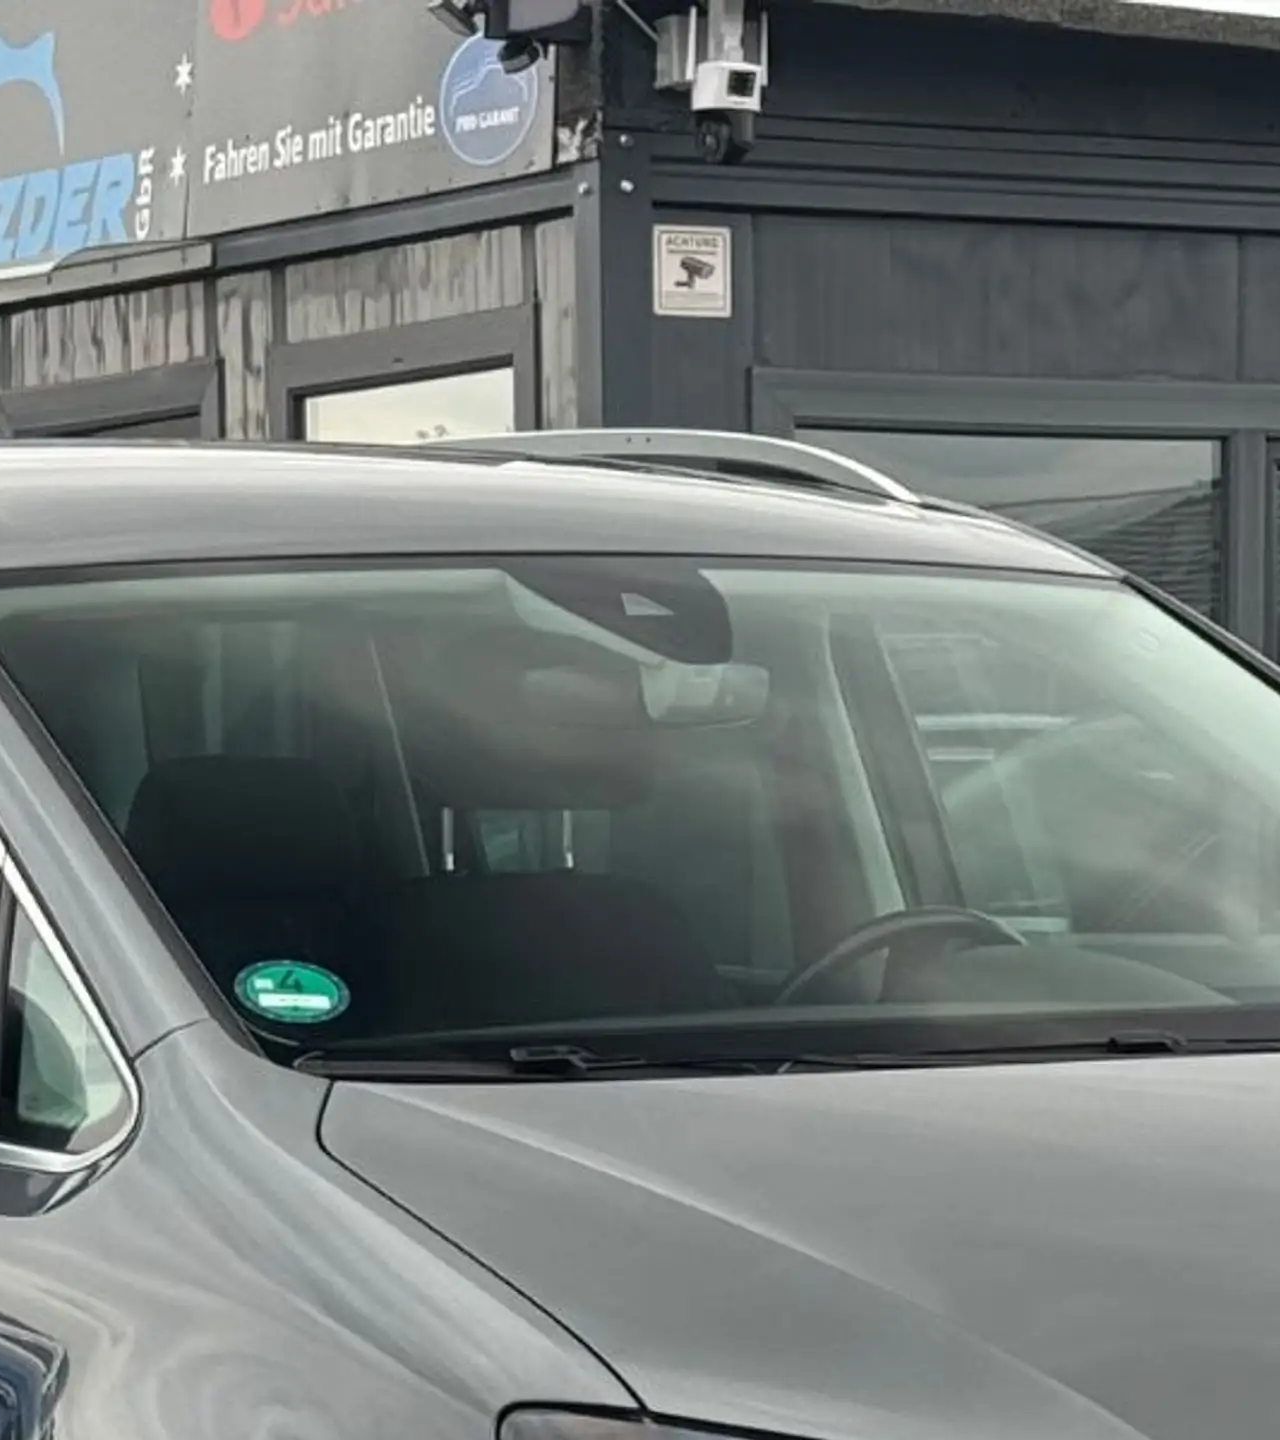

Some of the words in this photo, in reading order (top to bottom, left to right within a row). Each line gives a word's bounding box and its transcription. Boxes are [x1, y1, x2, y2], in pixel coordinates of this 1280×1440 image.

[203, 144, 269, 184] Fahren
[273, 126, 303, 167] Sie
[308, 125, 342, 161] mit
[347, 97, 435, 153] Garantie
[135, 146, 155, 241] GbR
